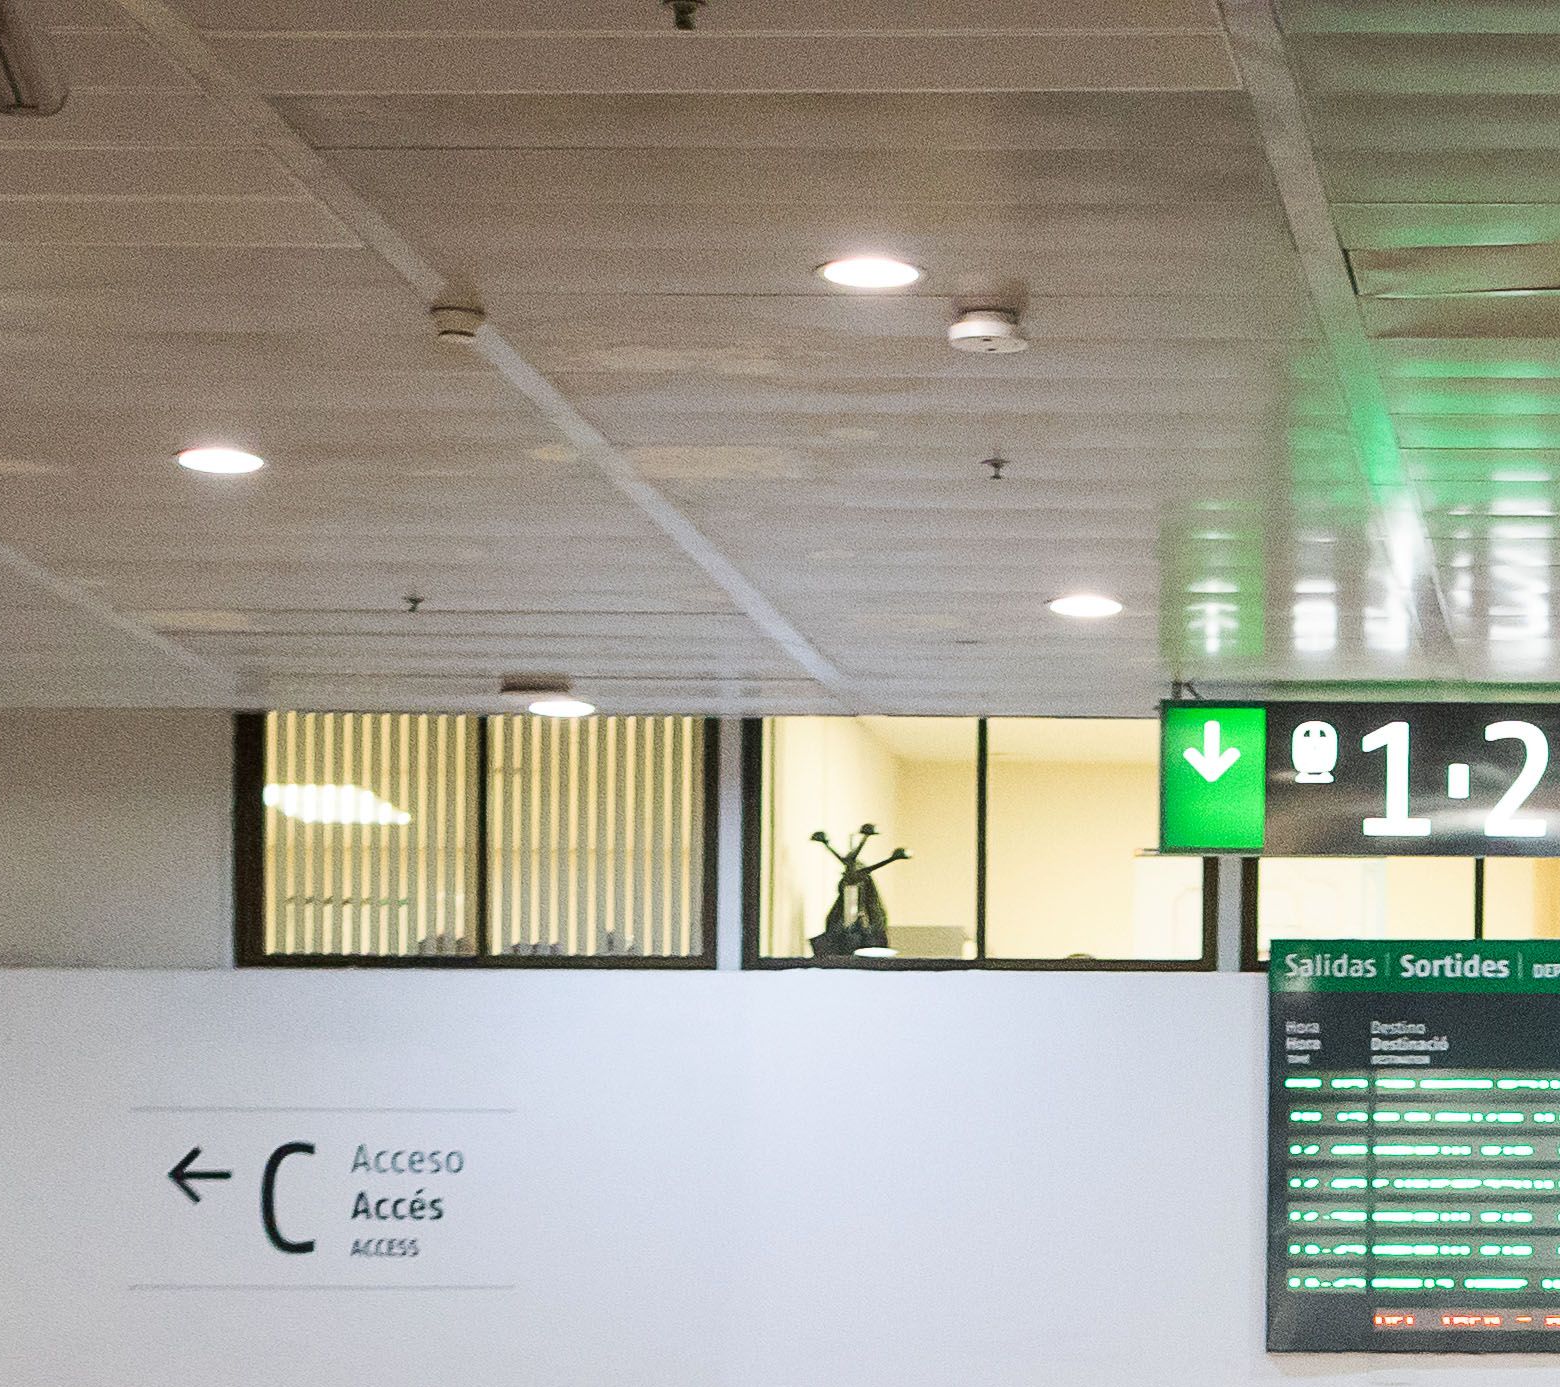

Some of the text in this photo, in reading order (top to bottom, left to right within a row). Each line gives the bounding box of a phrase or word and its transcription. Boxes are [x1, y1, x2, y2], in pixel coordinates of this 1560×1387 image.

[1284, 953, 1378, 979] Salidas
[1400, 954, 1510, 979] Sortides
[350, 1143, 466, 1175] Acceso
[260, 1140, 316, 1255] C
[350, 1187, 446, 1221] Accés
[349, 1237, 420, 1258] ACCESS
